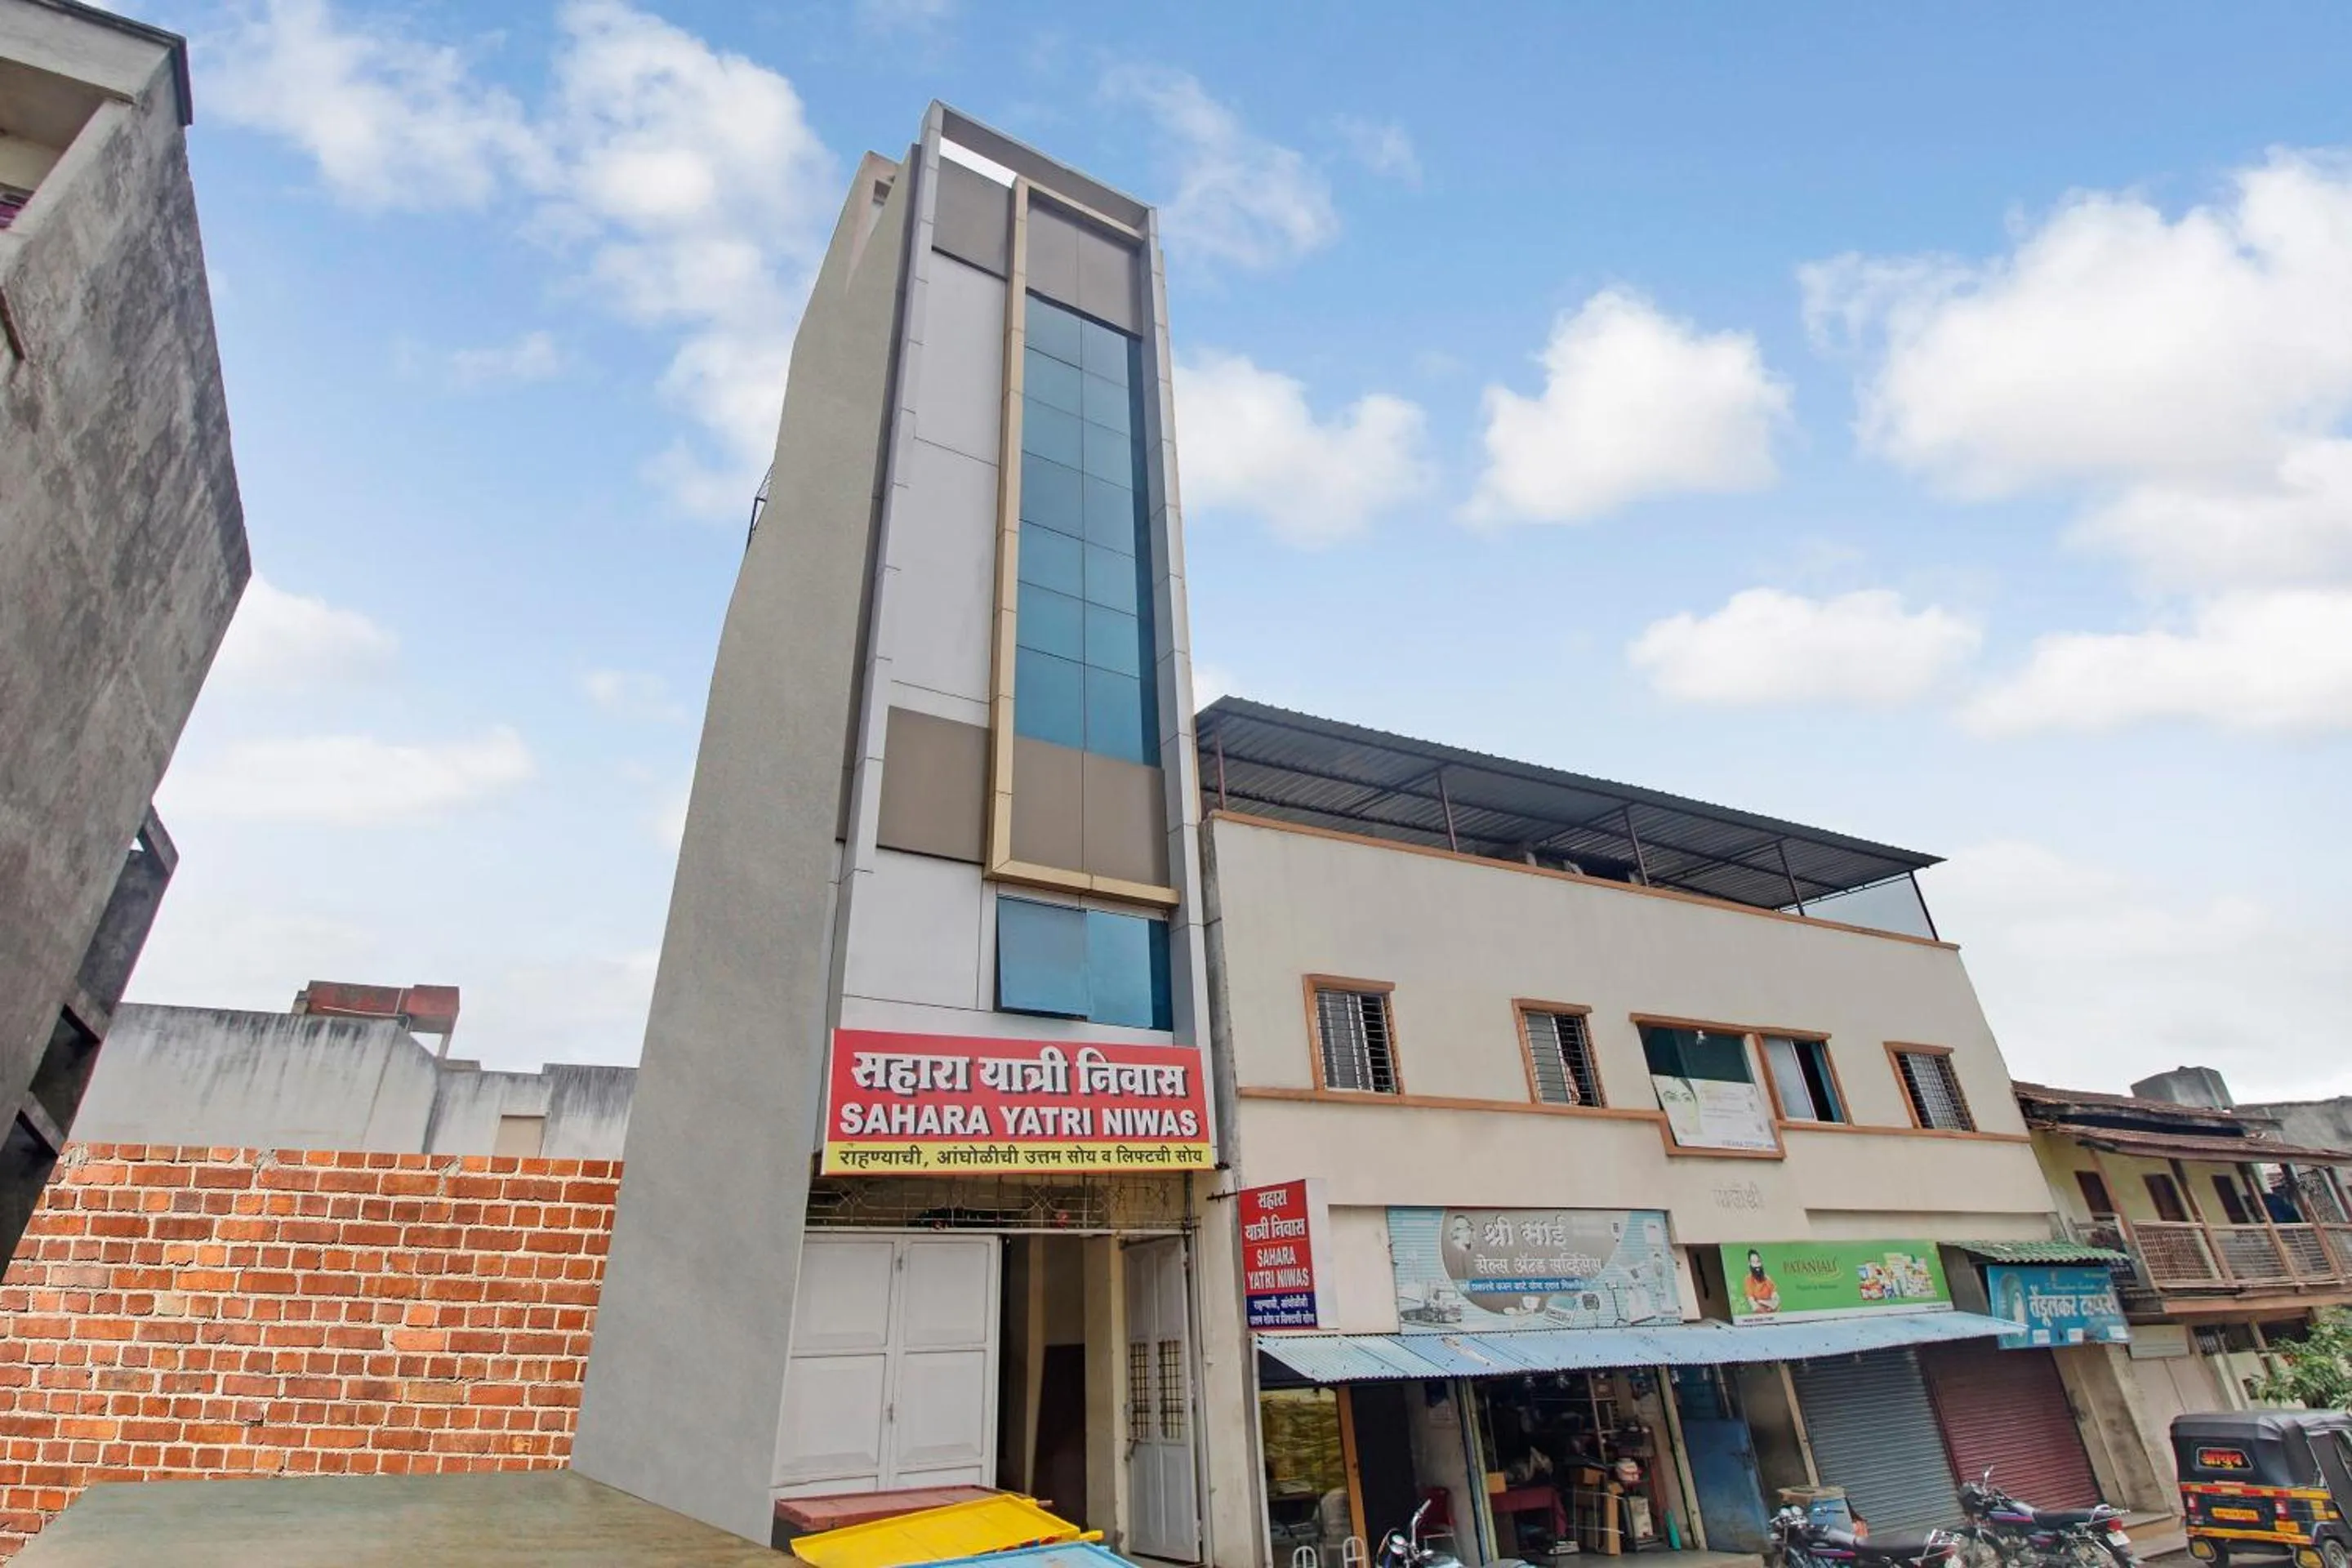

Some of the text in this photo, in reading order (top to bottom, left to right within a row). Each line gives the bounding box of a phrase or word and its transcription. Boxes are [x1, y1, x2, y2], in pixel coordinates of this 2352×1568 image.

[852, 1046, 1189, 1098] सहारा यात्री निवास
[840, 1102, 1200, 1138] SAHARA YATRI NIWAS
[1025, 1148, 1062, 1165] उत्तम
[1067, 1144, 1097, 1165] सोय
[1101, 1149, 1111, 1164] व
[1176, 1144, 1204, 1164] सोय
[1258, 1190, 1287, 1209] सहारा
[1245, 1214, 1306, 1241] यात्री निवास
[1482, 1214, 1568, 1249] श्री साई
[1257, 1246, 1297, 1267] SAHARA
[1473, 1254, 1511, 1276] सेल्स
[1248, 1267, 1310, 1290] YATRI NIWAS
